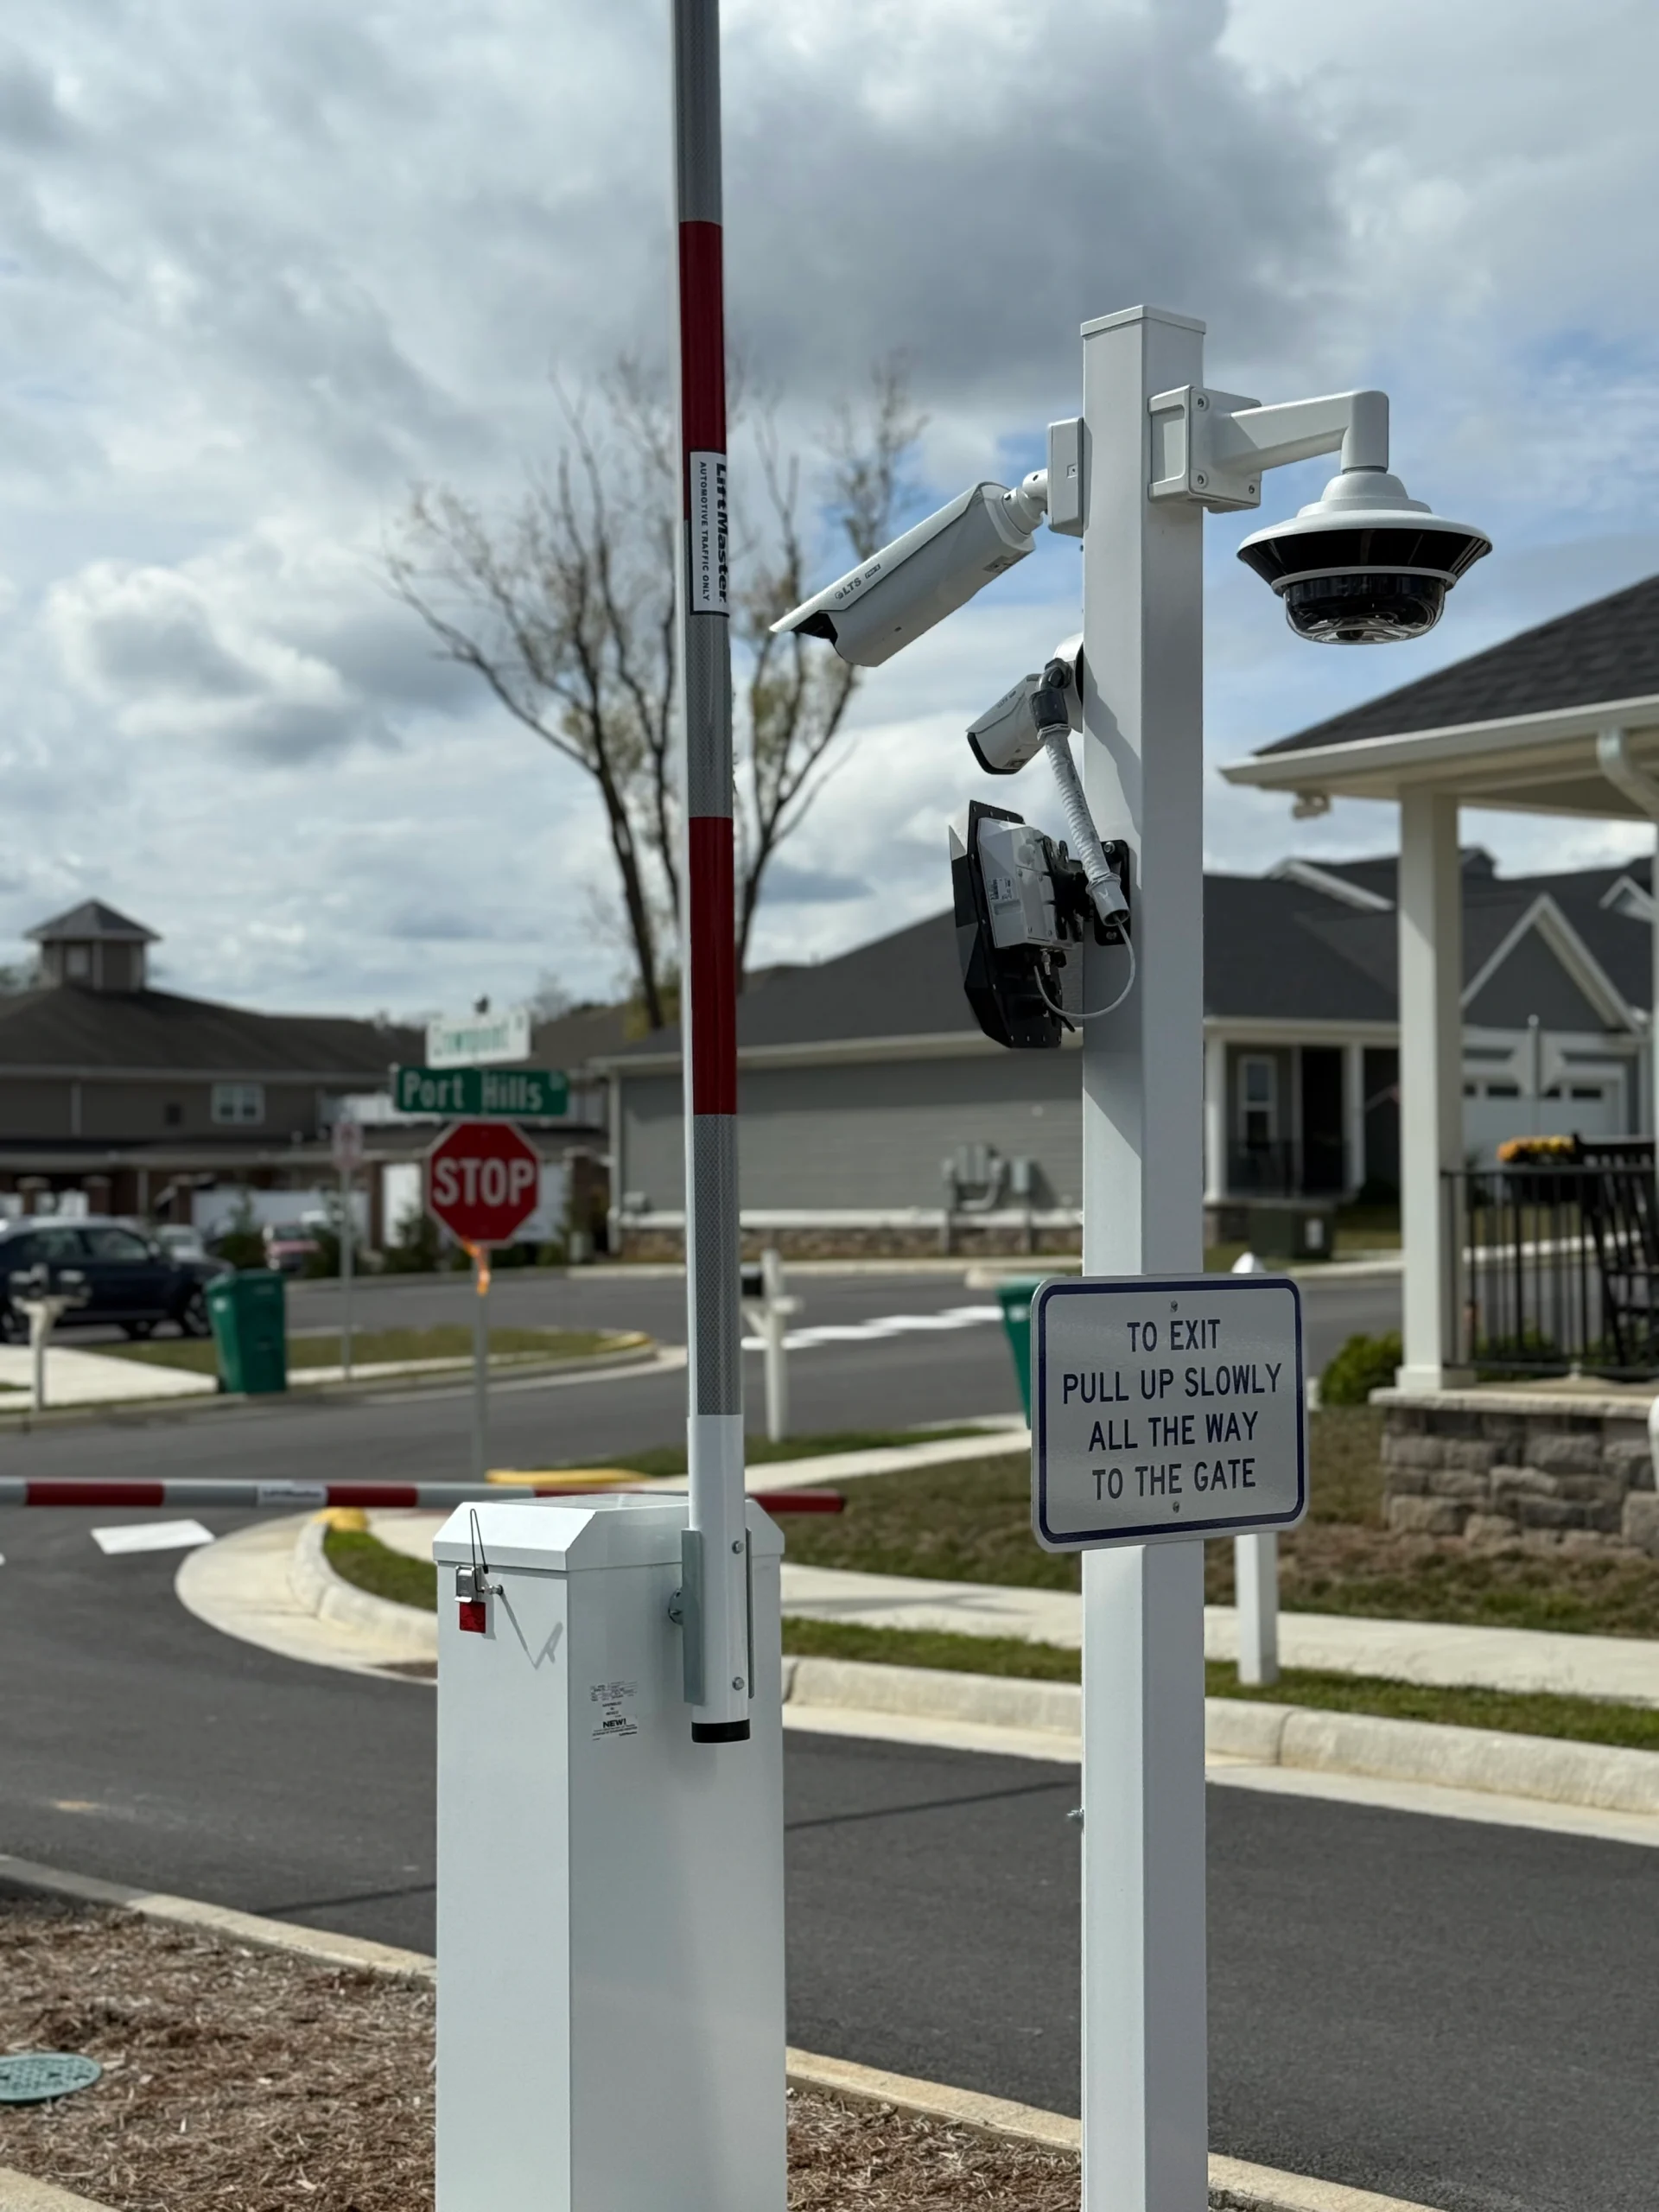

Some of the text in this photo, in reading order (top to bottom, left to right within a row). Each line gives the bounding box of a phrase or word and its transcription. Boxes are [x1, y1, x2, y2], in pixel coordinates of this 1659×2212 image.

[699, 461, 710, 601] AUTOMOTIVE TRAFFIC ONLY
[716, 461, 728, 603] LiftMaster
[842, 577, 861, 595] LTS
[402, 1071, 465, 1109] Port
[480, 1071, 543, 1111] Hills
[433, 1157, 536, 1207] STOP
[1126, 1319, 1221, 1353] TO EXIT
[1062, 1362, 1283, 1405] PULL UP SLOWLY
[1087, 1410, 1259, 1452] ALL THE WAY
[1091, 1458, 1257, 1501] TO THE GATE
